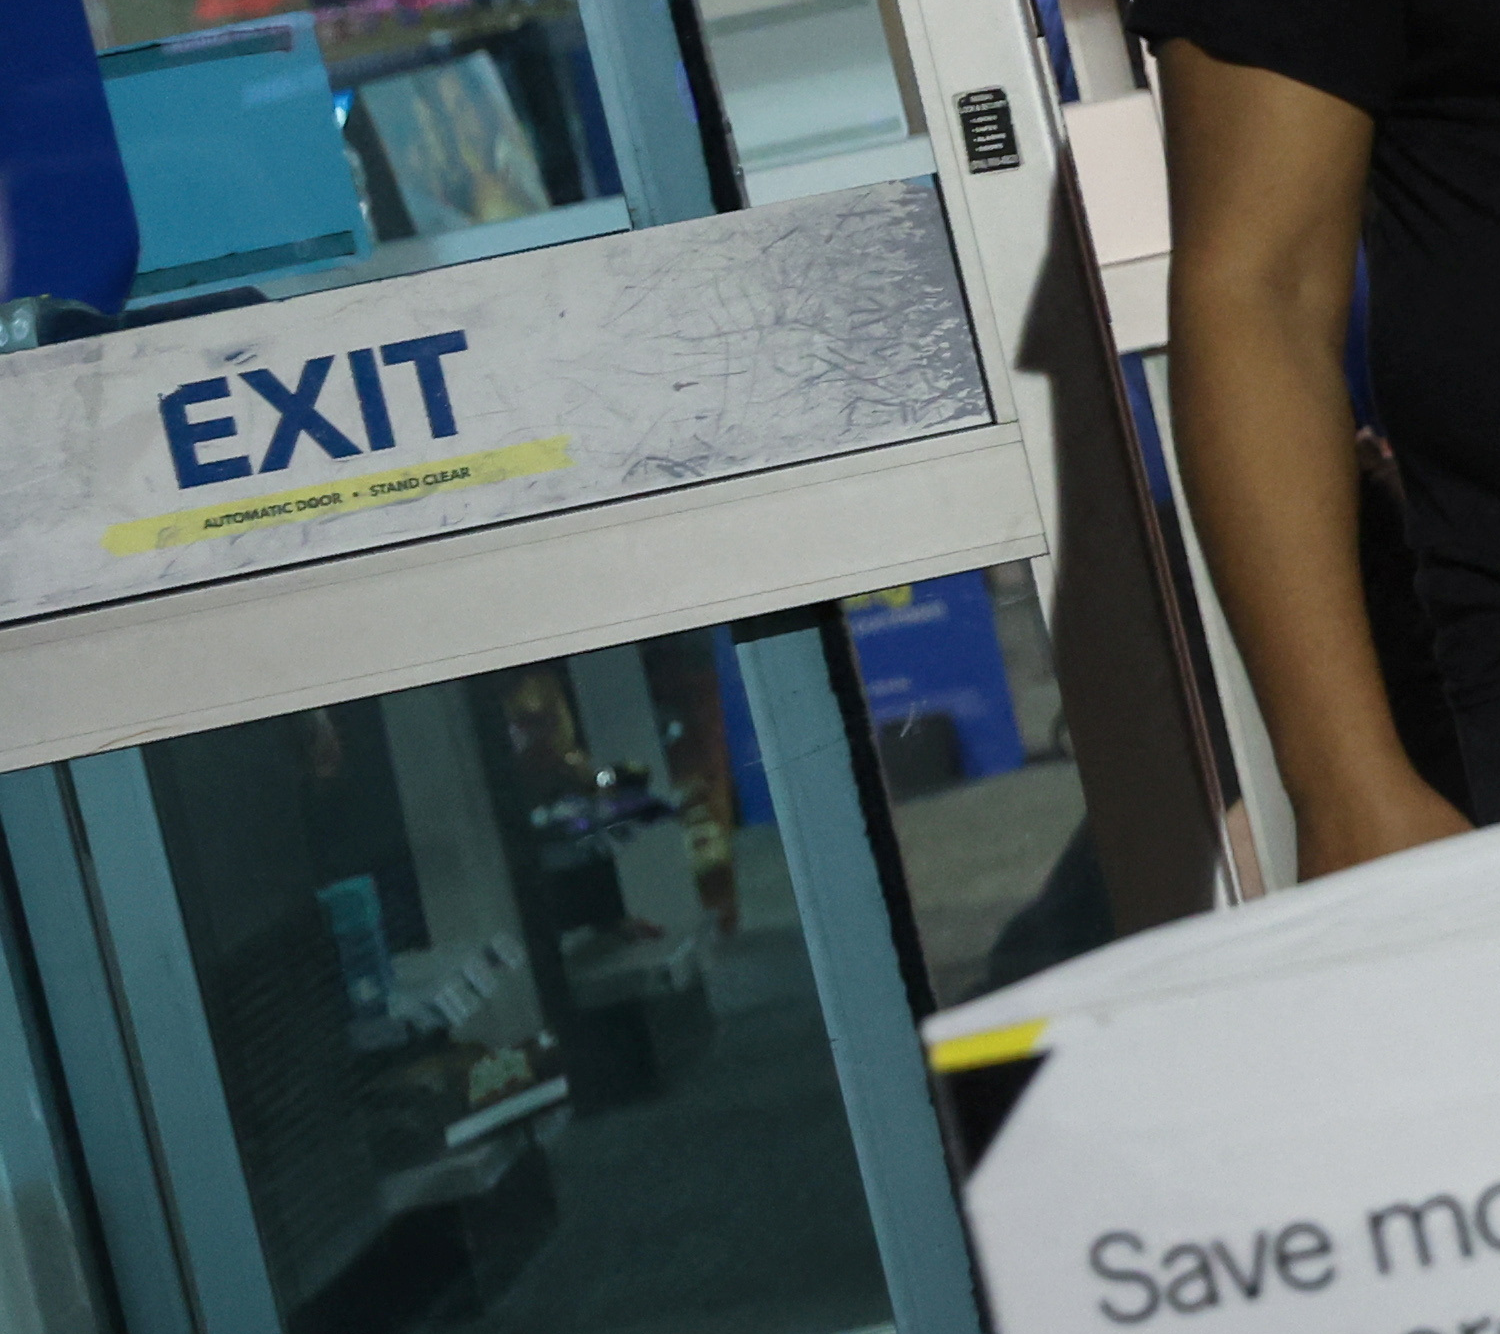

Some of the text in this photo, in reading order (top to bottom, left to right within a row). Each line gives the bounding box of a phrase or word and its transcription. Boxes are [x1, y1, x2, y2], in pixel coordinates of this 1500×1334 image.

[158, 329, 468, 490] EXIT
[203, 466, 471, 531] AUTOMATIC DOOR STAND CLEAR
[1087, 1224, 1334, 1327] Save
